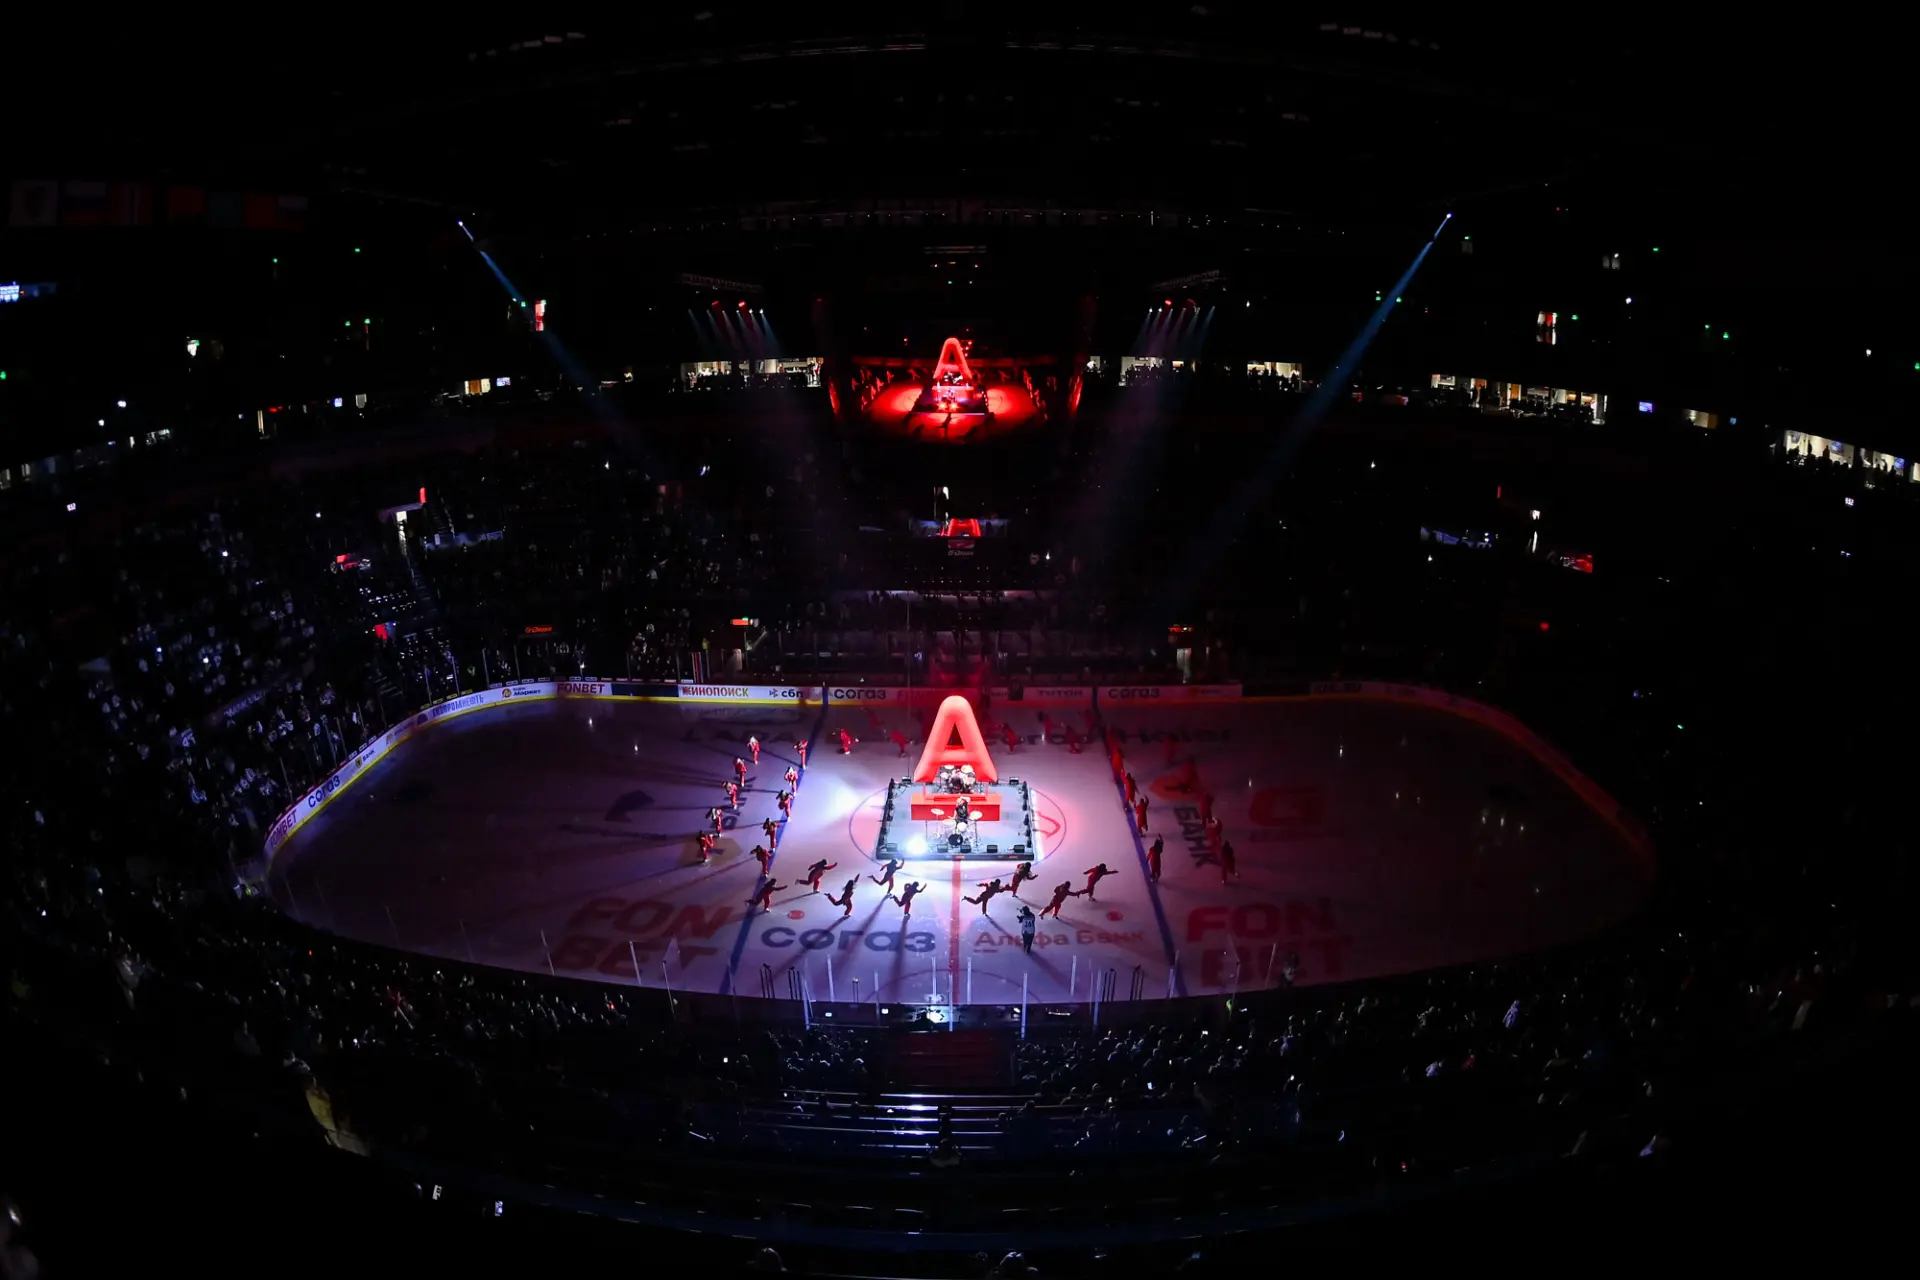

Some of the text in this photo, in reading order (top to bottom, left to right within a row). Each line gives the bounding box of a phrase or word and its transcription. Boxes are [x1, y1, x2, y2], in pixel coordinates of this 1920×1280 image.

[557, 682, 605, 695] FONBET
[834, 688, 887, 700] согаз
[1108, 687, 1160, 699] согаз
[308, 775, 341, 808] согаз
[269, 809, 297, 850] FONBET
[563, 897, 735, 940] FON
[1187, 898, 1336, 943] FON
[761, 926, 937, 953] согаз
[1076, 930, 1145, 946] Банк
